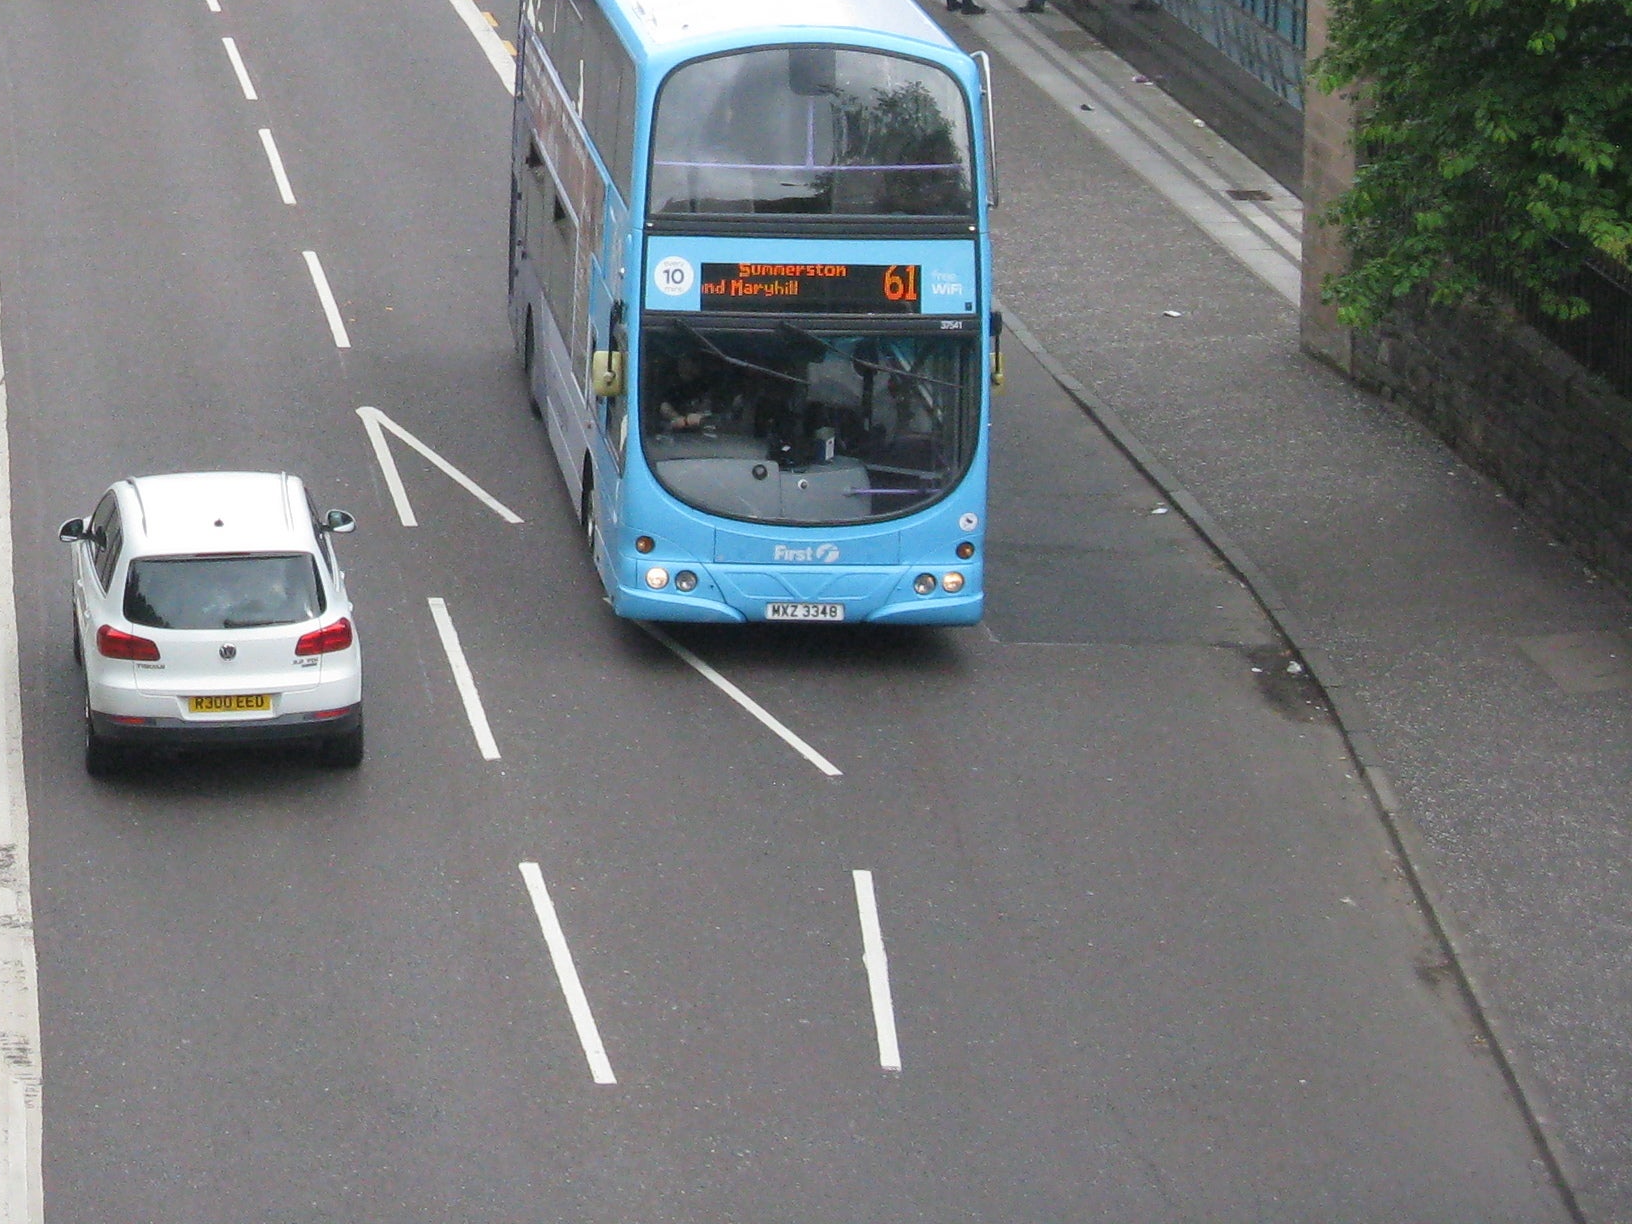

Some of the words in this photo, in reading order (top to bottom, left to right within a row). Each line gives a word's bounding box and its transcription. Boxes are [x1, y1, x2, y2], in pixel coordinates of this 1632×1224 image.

[663, 268, 685, 284] 10
[739, 263, 848, 278] Summerston
[731, 279, 800, 297] Maryhill
[884, 265, 917, 301] 61
[773, 544, 814, 561] First
[772, 604, 799, 617] MXZ
[802, 604, 838, 618] 3348
[194, 696, 233, 709] R300
[236, 695, 264, 708] EED
